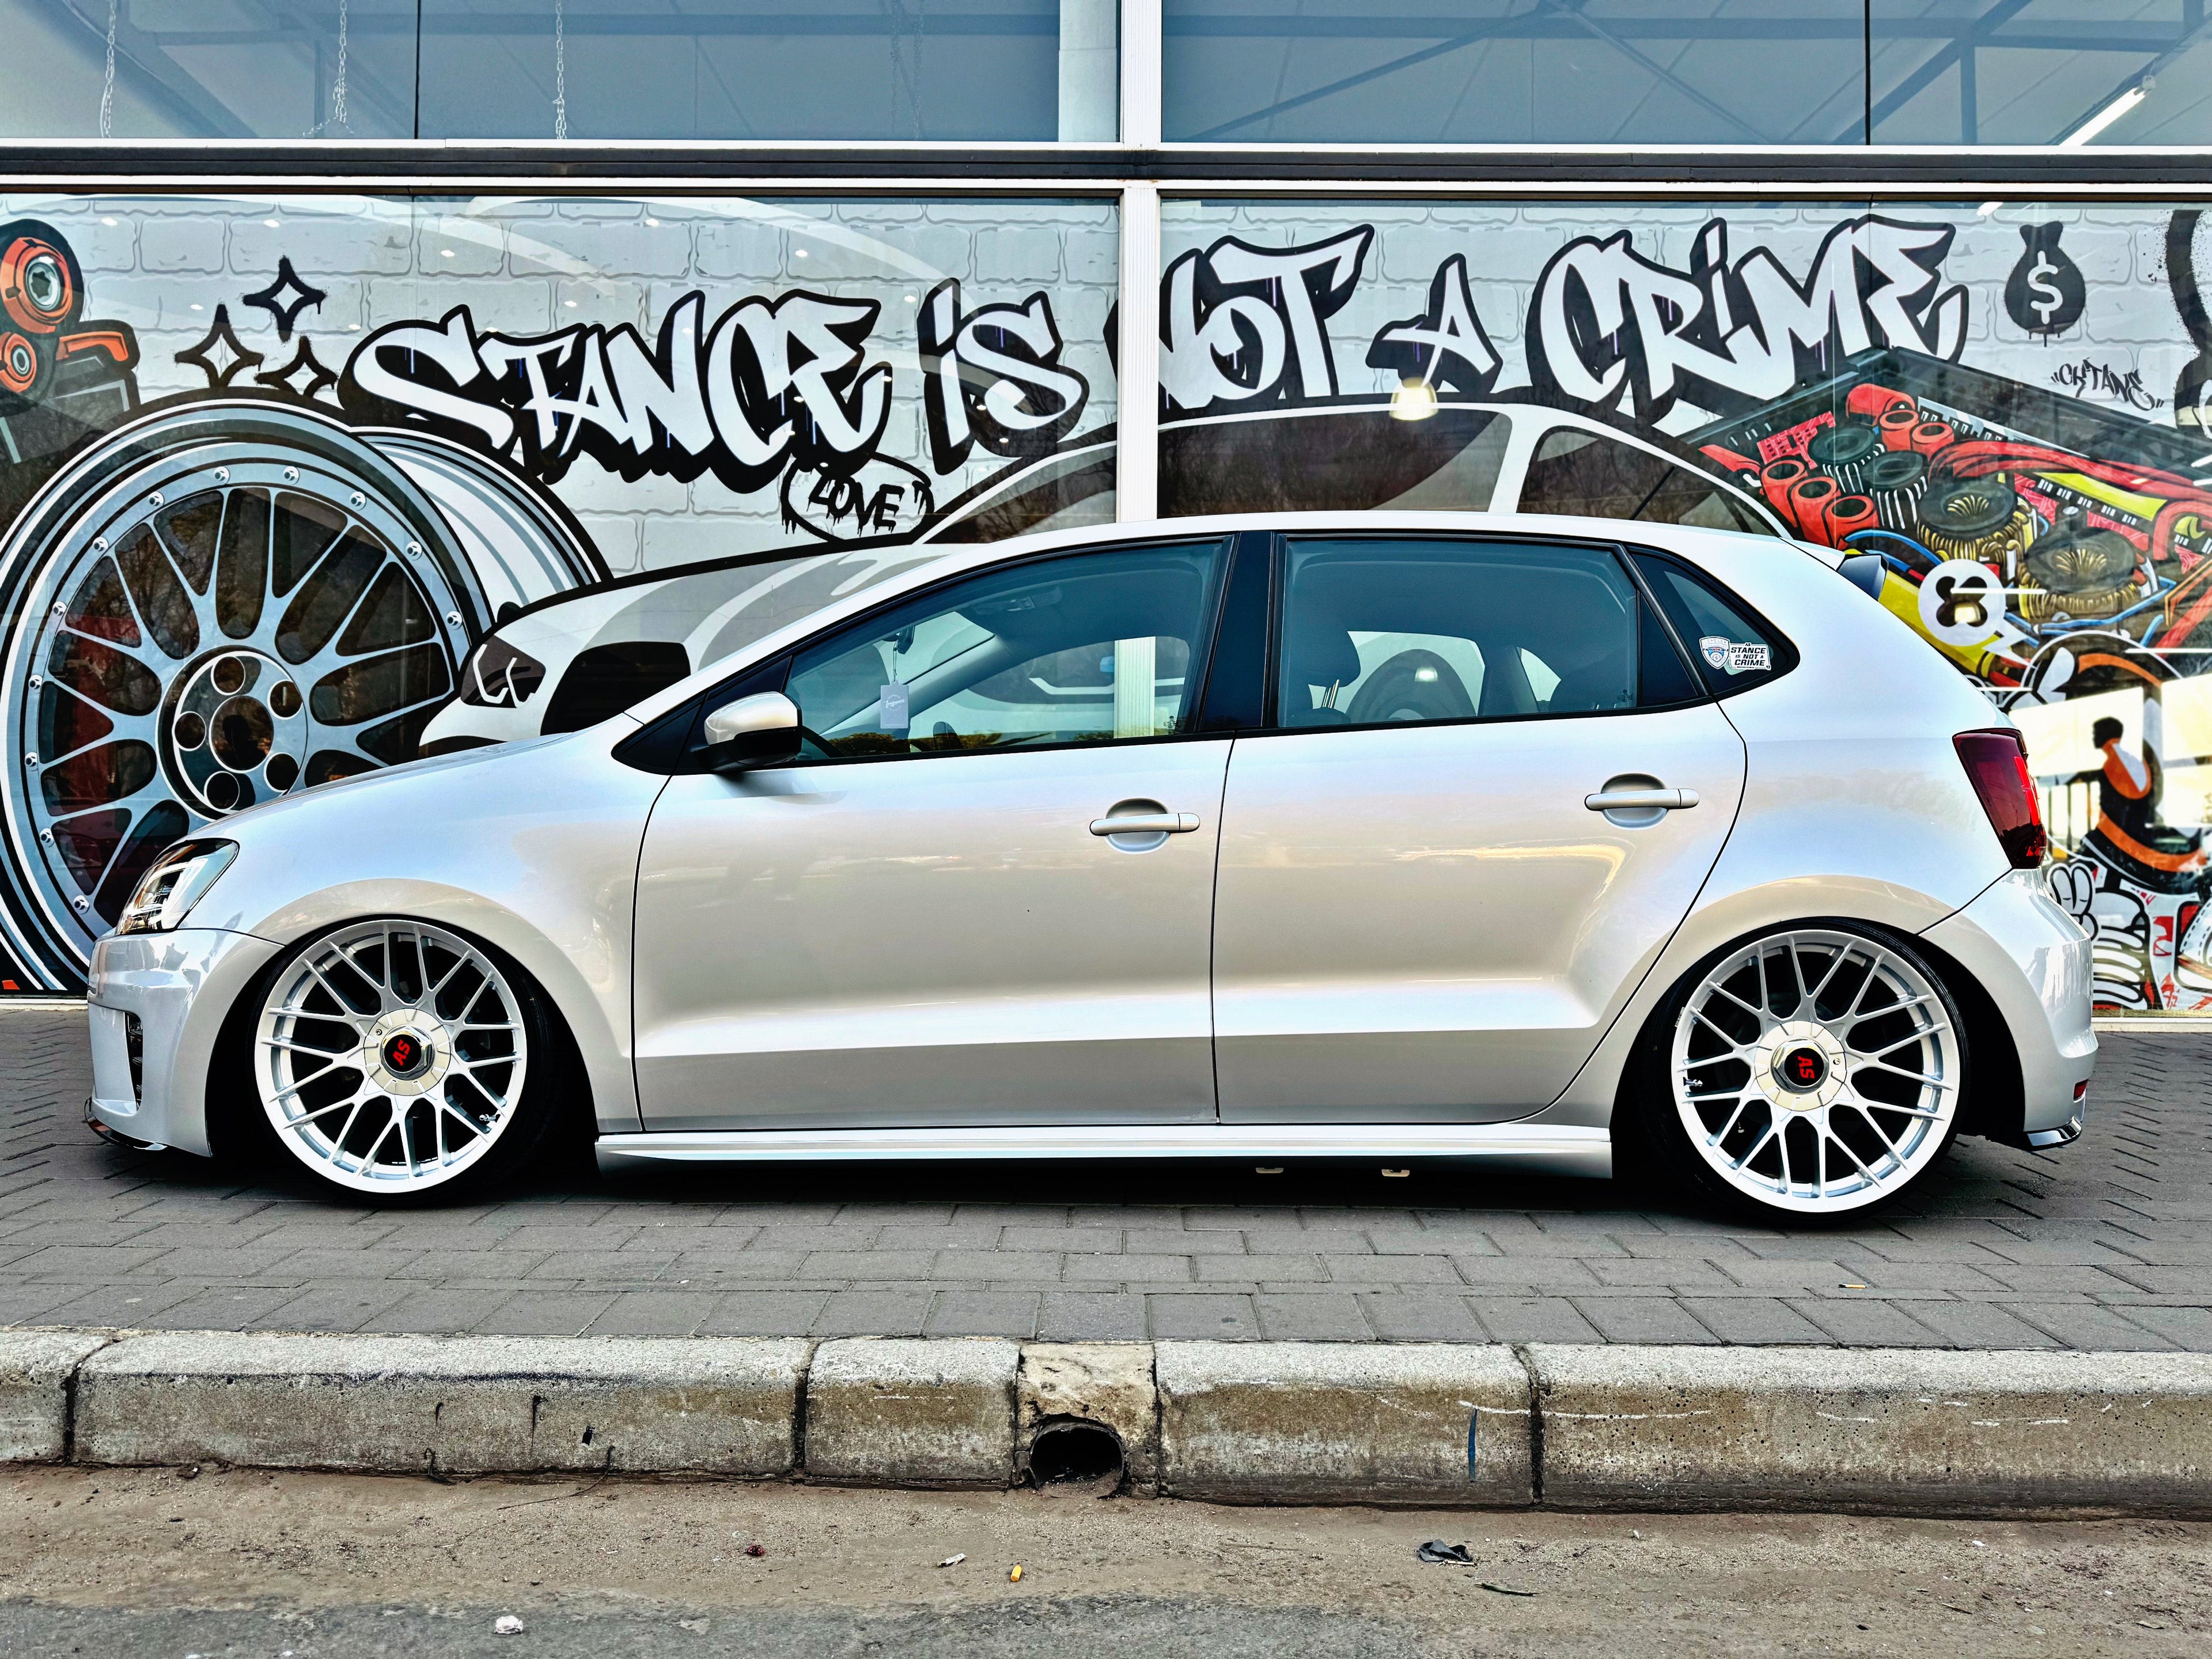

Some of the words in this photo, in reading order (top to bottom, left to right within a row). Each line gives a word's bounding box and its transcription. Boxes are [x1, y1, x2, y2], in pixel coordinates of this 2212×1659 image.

[344, 291, 891, 477] STANCE
[923, 280, 1086, 462] IS
[1374, 257, 1500, 392] A
[1532, 218, 1967, 409] CRIME
[808, 476, 906, 533] LOVE
